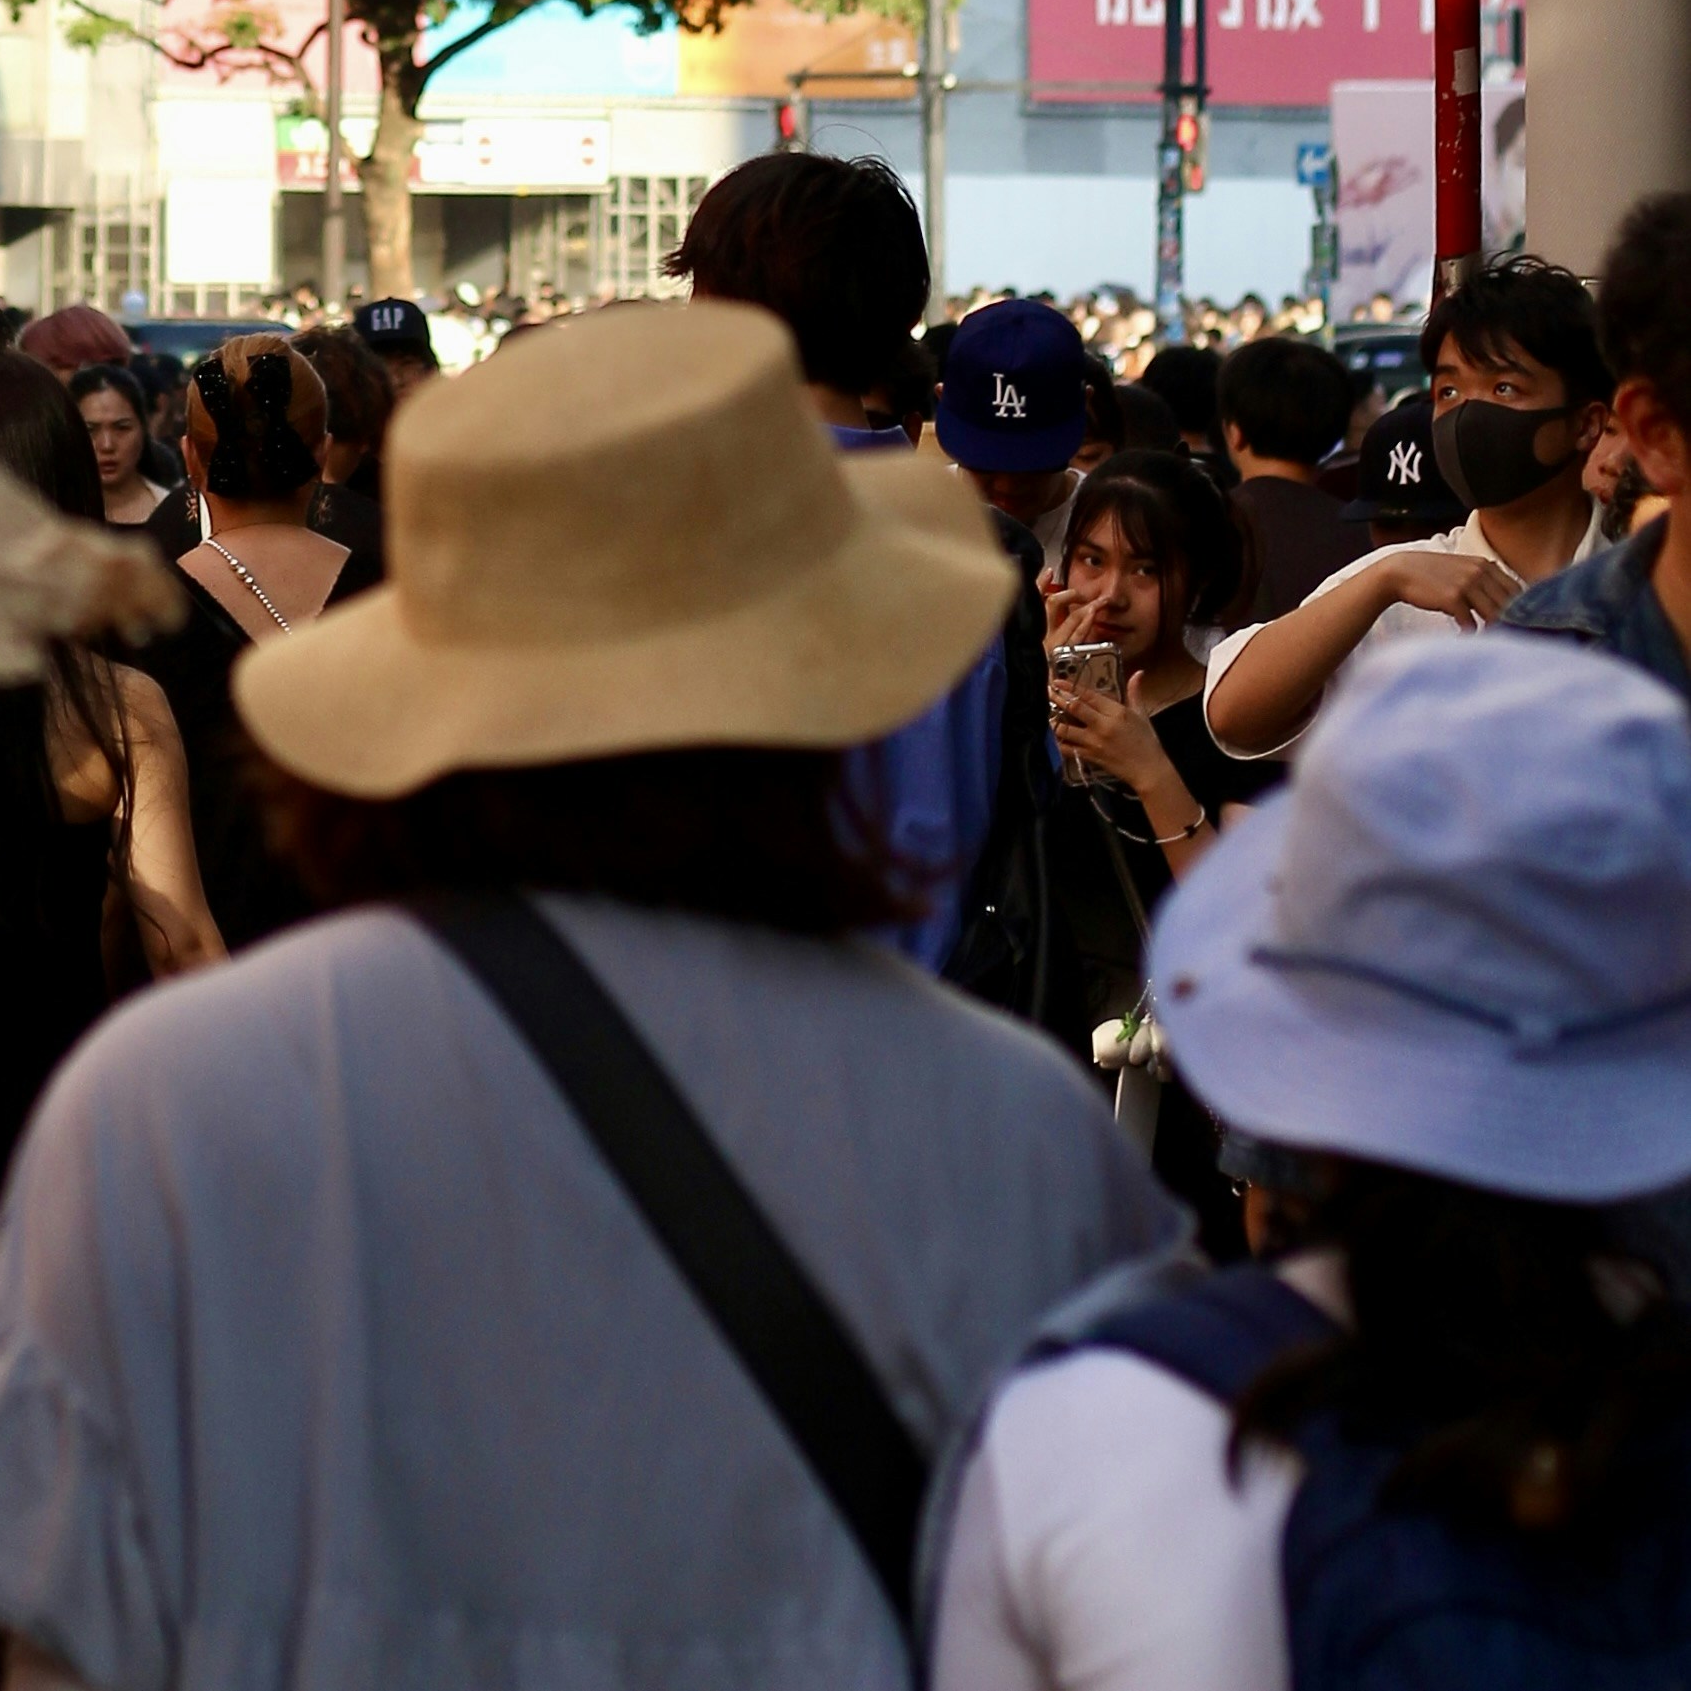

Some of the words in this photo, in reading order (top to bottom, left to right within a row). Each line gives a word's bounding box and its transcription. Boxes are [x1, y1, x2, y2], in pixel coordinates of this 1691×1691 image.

[371, 306, 404, 331] GAP
[992, 372, 1026, 417] LA
[1387, 440, 1422, 485] NY
